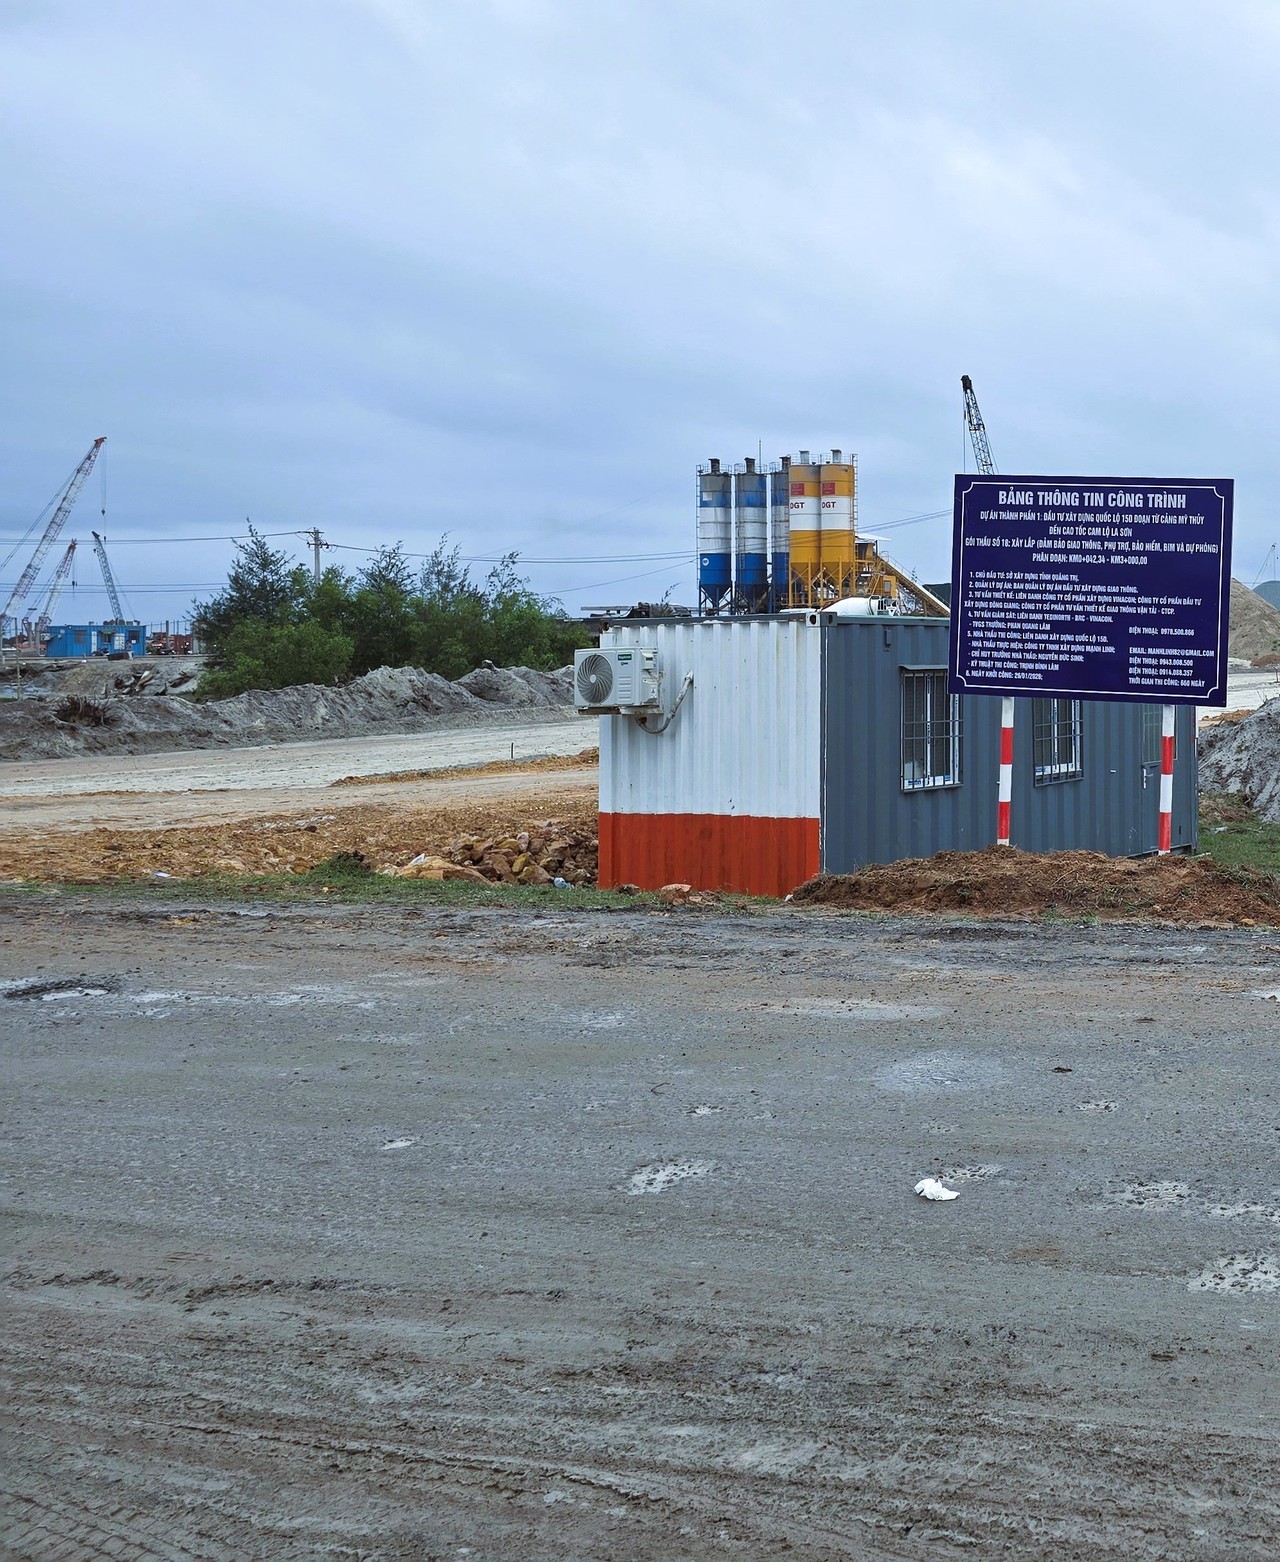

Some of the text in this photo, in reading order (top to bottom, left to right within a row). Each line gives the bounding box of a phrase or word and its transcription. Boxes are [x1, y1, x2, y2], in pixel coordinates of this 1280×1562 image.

[999, 488, 1186, 508] BẢNG THÔNG TIN CÔNG TRÌNH
[980, 509, 1204, 525] DỰ ÁN THÀNH PHẦN 1: ĐẦU TƯ XÂY DỰNG QUỐC LỘ 15D ĐOẠN TỪ CẢNG MỸ THỦY
[1049, 523, 1132, 538] ĐẾN CAO TỐC CAM LỘ LA SƠN
